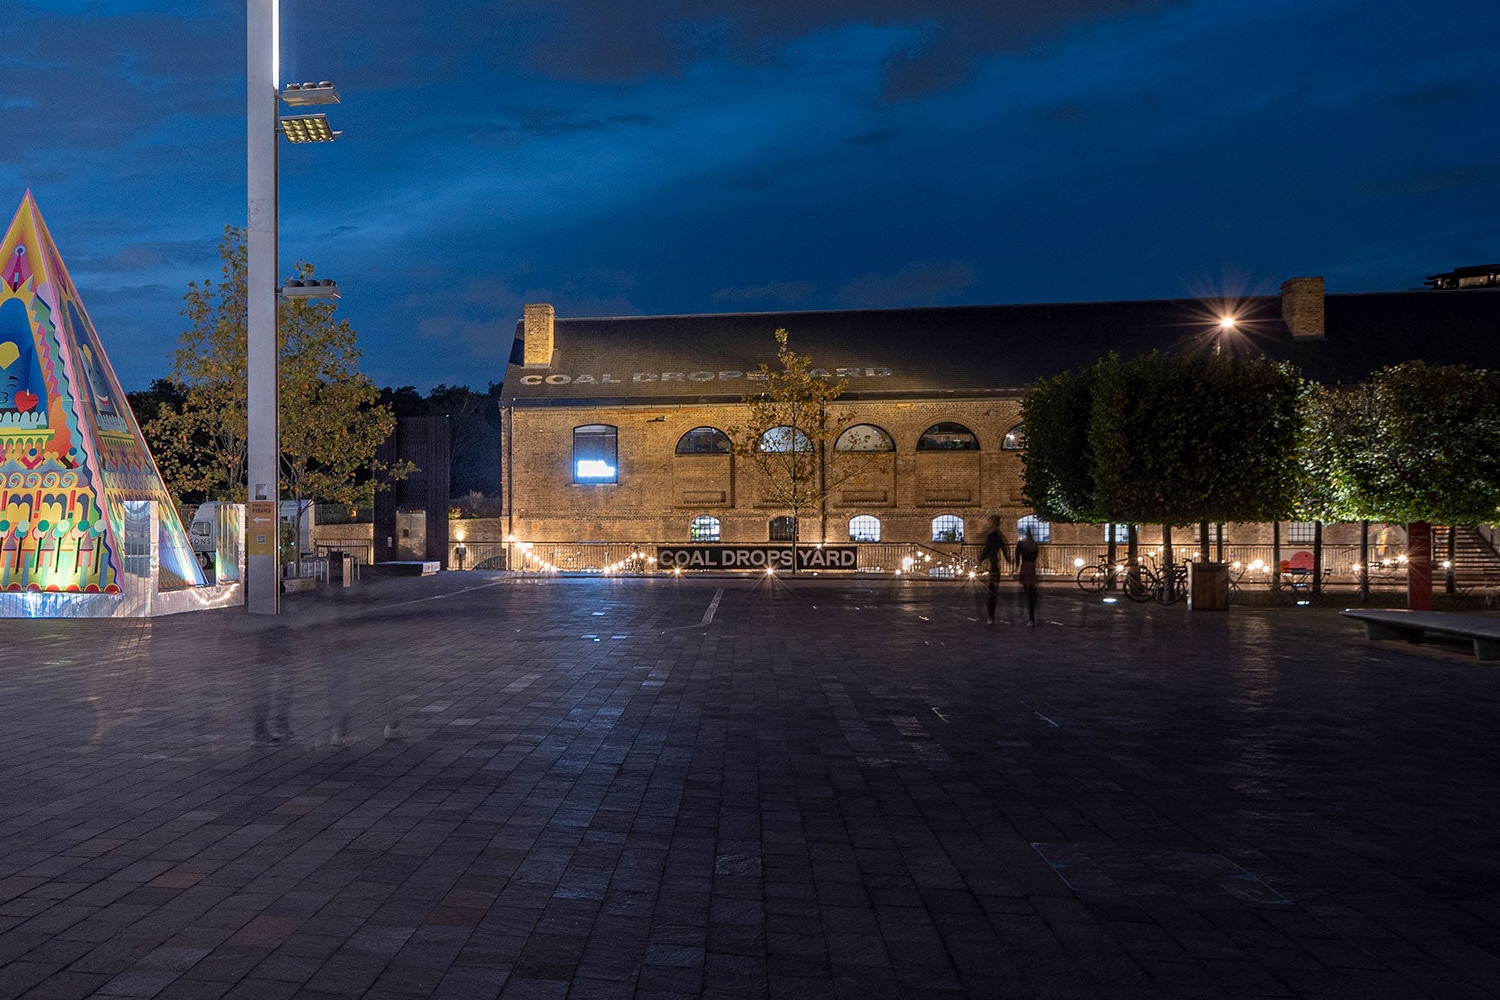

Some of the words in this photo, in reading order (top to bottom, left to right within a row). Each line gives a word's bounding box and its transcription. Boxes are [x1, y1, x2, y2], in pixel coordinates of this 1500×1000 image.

[520, 373, 621, 385] COAL
[780, 367, 893, 378] ARD
[659, 549, 717, 566] COAL
[722, 549, 793, 566] DROPS
[798, 549, 856, 566] YARD
